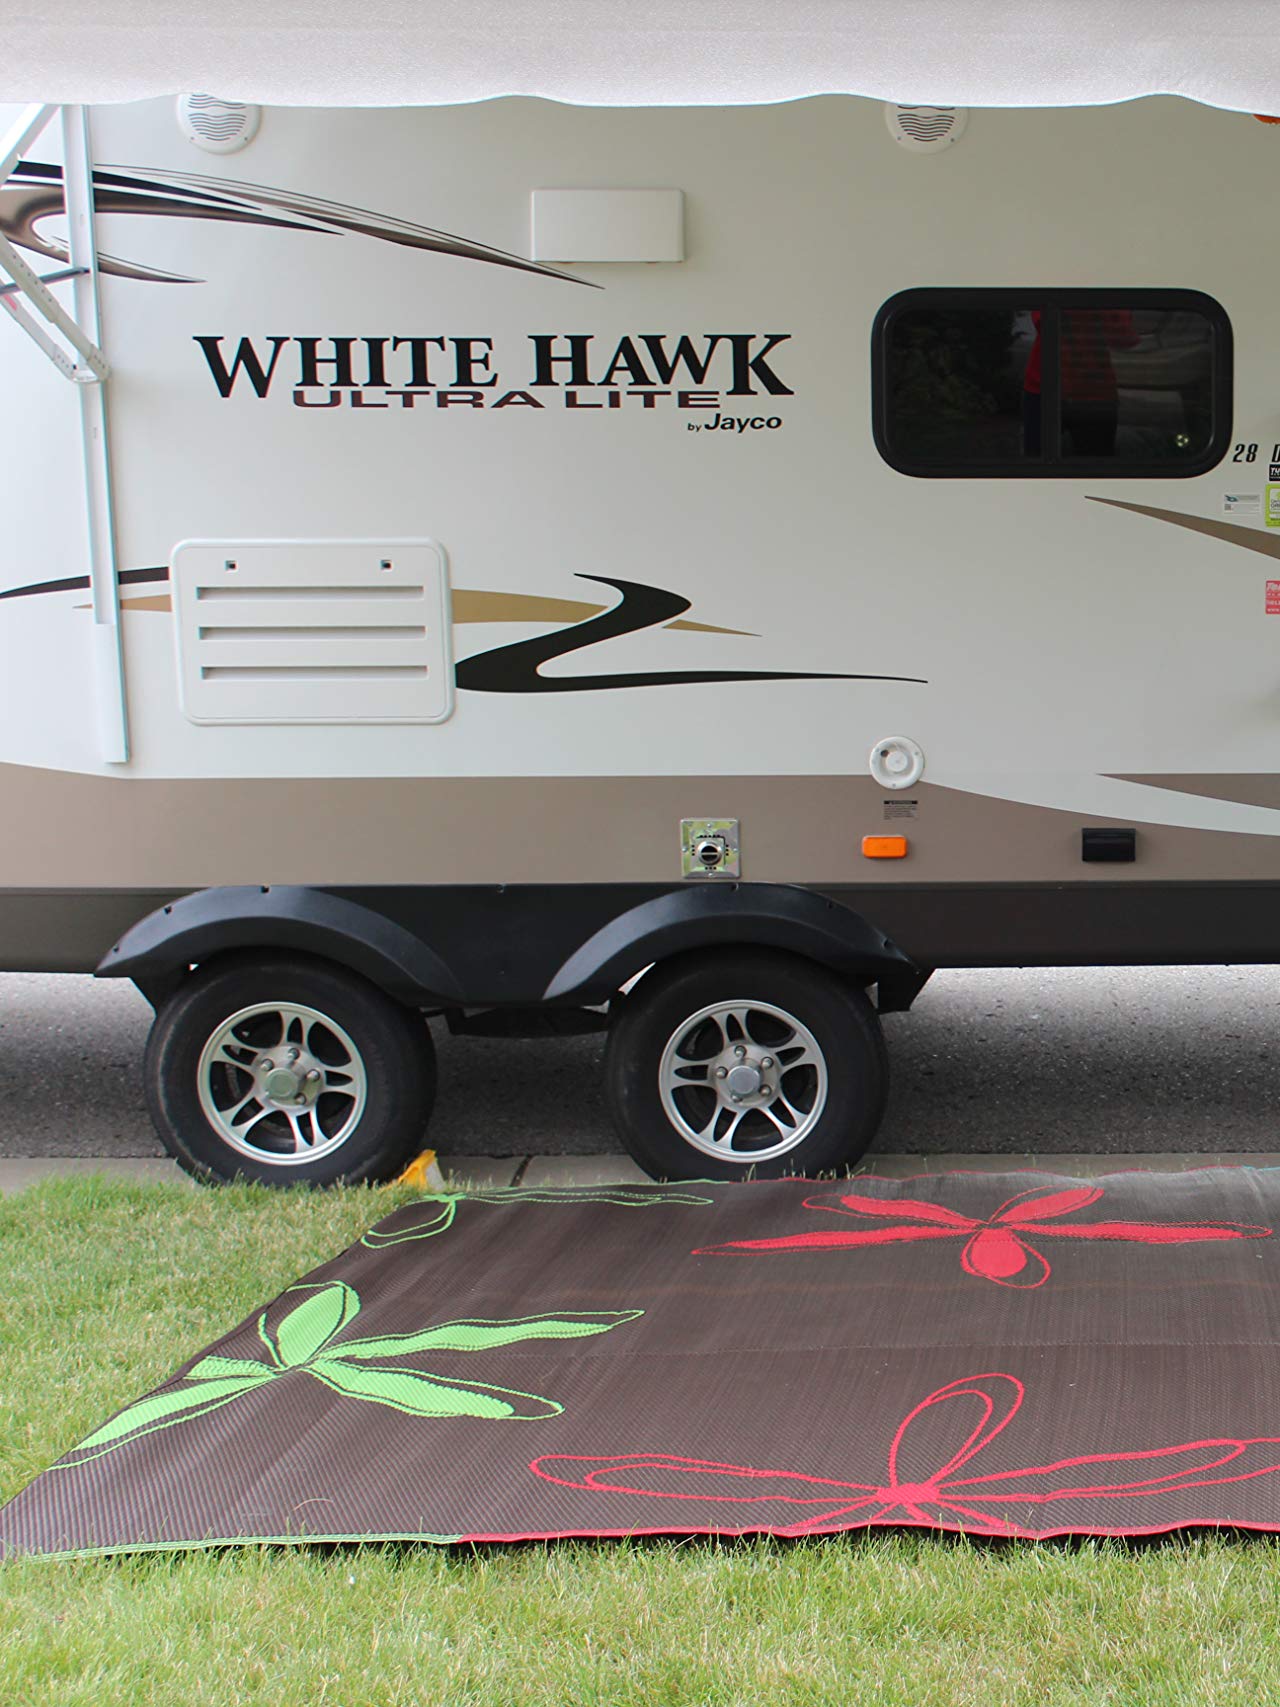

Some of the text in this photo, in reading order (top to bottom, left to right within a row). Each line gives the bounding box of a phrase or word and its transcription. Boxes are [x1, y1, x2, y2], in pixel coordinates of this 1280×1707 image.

[192, 333, 795, 398] WHITE HAWK
[292, 389, 721, 409] ULTRA LITE
[687, 412, 783, 434] by Jayco
[1232, 443, 1259, 463] 28
